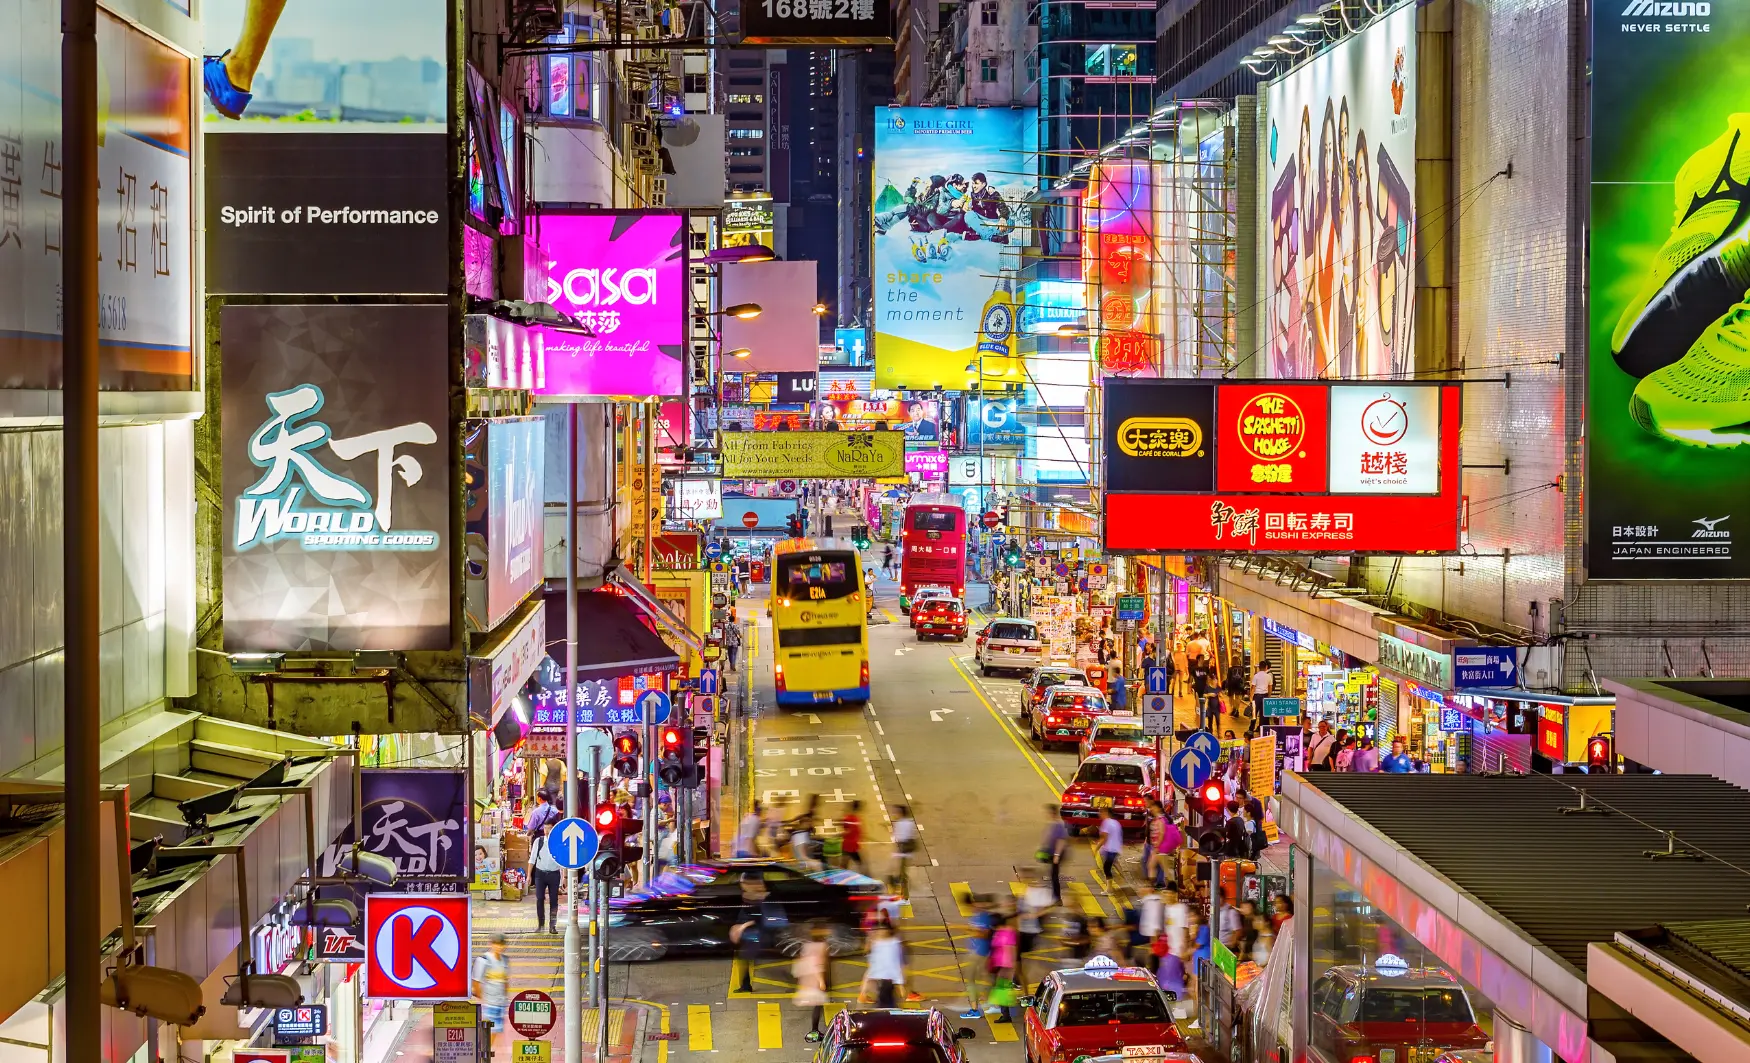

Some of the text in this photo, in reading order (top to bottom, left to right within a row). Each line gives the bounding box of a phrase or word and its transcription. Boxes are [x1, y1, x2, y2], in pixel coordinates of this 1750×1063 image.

[1621, 24, 1711, 32] NEVER SETTLE
[770, 71, 778, 150] GALA PLACE
[914, 120, 942, 128] BLUE
[946, 120, 974, 128] GIRL
[220, 205, 439, 226] Spirit of Performance
[887, 270, 943, 284] share
[887, 289, 918, 303] the
[887, 307, 964, 321] moment
[574, 311, 621, 334] 莎莎
[545, 340, 650, 357] making life beautiful
[1256, 396, 1285, 415] THE
[740, 440, 769, 452] from
[772, 440, 813, 450] Fabrics
[1253, 436, 1292, 455] HOUSE
[244, 383, 438, 532] 天下
[737, 453, 753, 464] for
[754, 454, 778, 463] Your
[782, 454, 813, 463] Needs
[837, 449, 883, 463] NaRaYa
[236, 487, 374, 547] WORLD
[1265, 512, 1354, 531] 回転寿司
[1265, 532, 1353, 540] SUSHI EXPRESS
[1612, 525, 1659, 538] 日本設計
[304, 534, 435, 546] SPORTING GOODS
[1613, 547, 1730, 555] JAPAN ENGINEERED
[761, 747, 839, 757] BUS
[754, 767, 856, 777] STOP
[392, 914, 454, 989] K
[518, 1002, 548, 1012] 904 905
[447, 1028, 464, 1040] E21A
[524, 1045, 538, 1054] 905
[1127, 1047, 1161, 1056] TAXI
